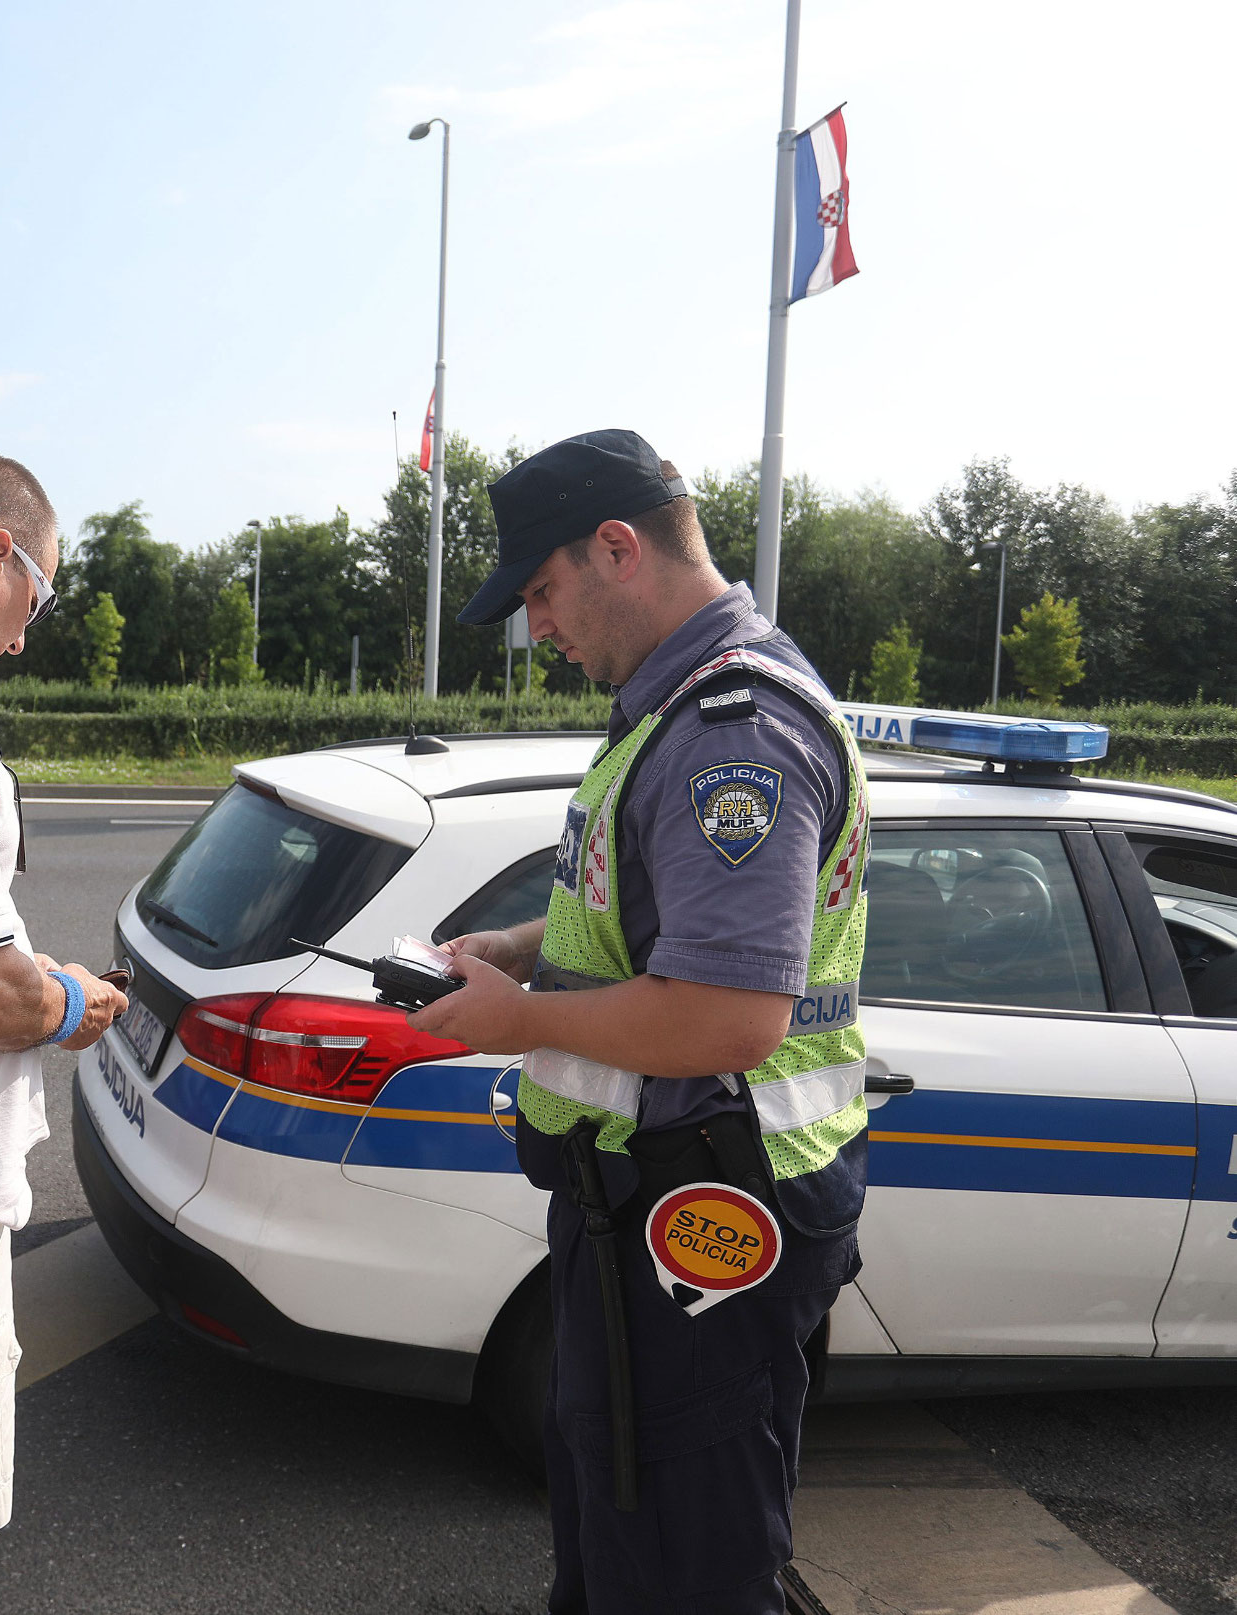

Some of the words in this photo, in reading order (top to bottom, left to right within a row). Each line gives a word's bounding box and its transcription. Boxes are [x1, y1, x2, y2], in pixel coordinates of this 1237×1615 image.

[696, 769, 774, 790] POLICIJA
[718, 800, 753, 816] RH
[716, 819, 755, 829] MUP
[674, 1210, 760, 1248] STOP
[666, 1229, 747, 1271] POLICIJA
